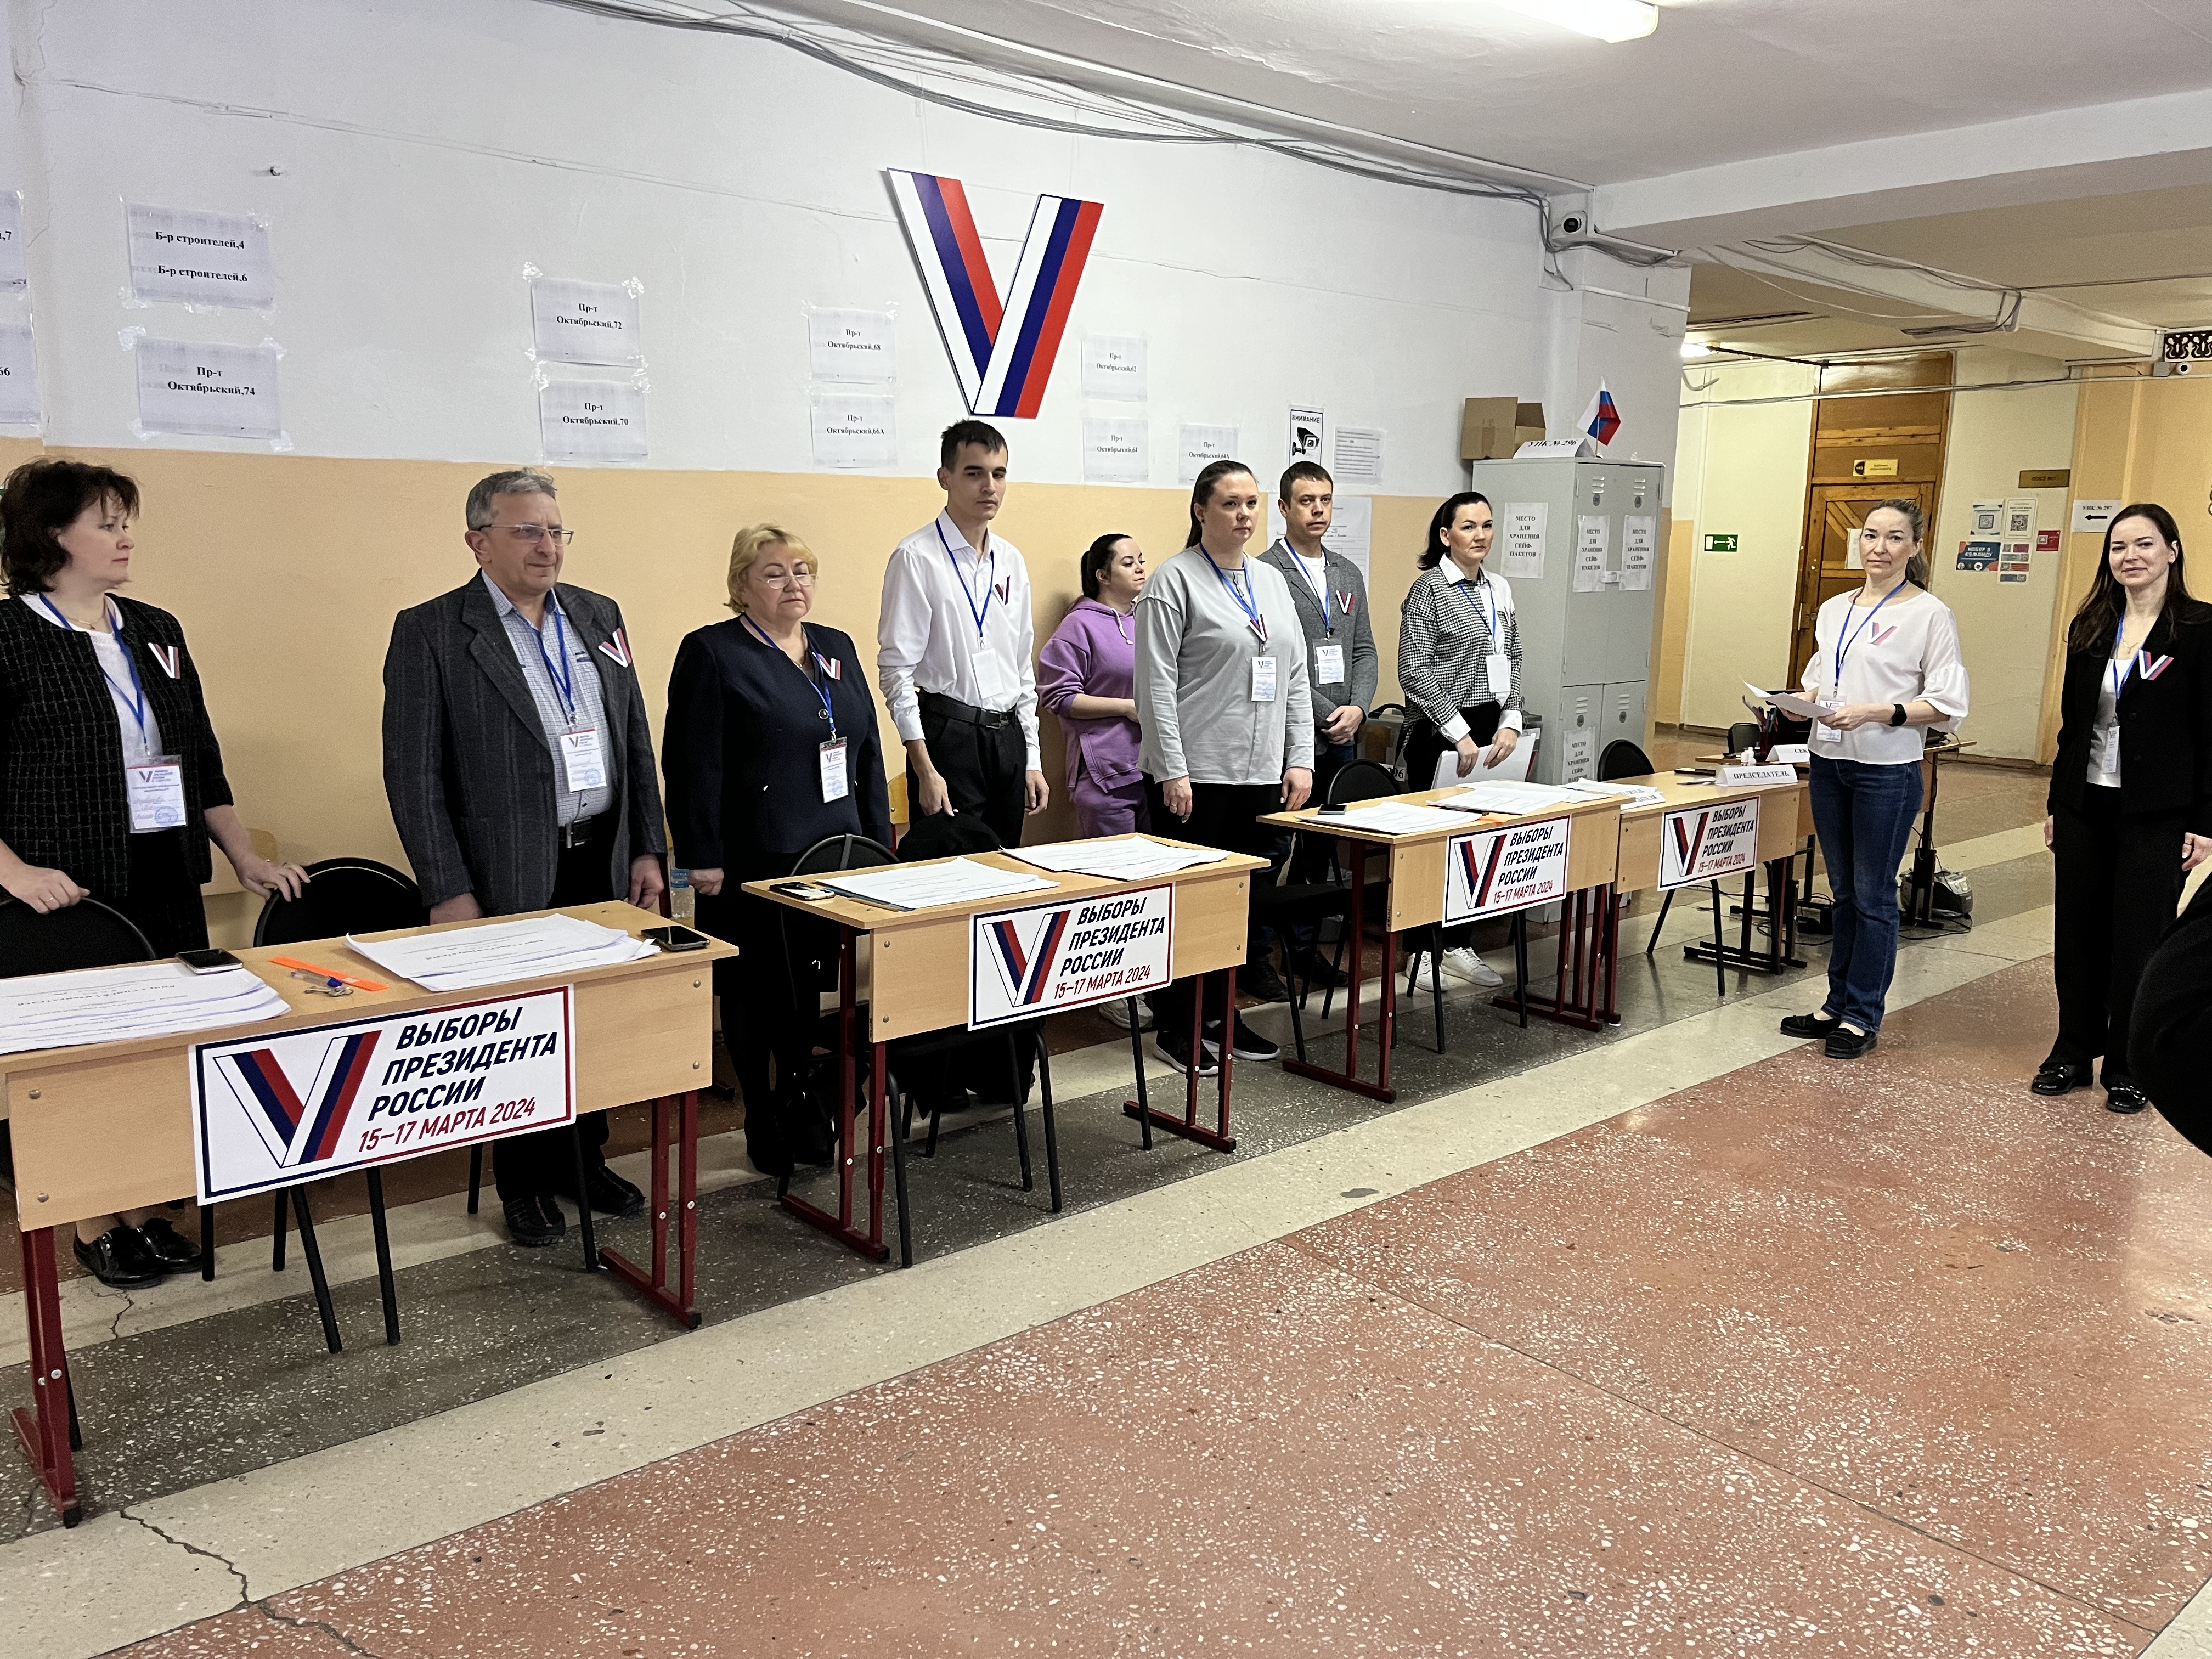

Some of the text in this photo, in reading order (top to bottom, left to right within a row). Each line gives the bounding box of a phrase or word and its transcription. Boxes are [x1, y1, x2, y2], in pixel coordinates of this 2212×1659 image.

[155, 231, 245, 249] Б-р строителей,4
[158, 265, 176, 276] Б-р
[579, 303, 598, 313] Пр-т
[557, 315, 622, 329] Октябрьский,72
[846, 329, 861, 337] Пр-т
[197, 366, 223, 378] Пр-т
[168, 381, 255, 396] Октябрьский,74
[584, 402, 603, 412] Пр-т
[563, 416, 629, 426] Октябрьский,70
[847, 414, 863, 423] Пр-т
[1734, 771, 1790, 780] ПРЕДСЕДАТЕЛЬ
[1712, 805, 1746, 823] ВЫБОРЫ
[1510, 826, 1554, 847] ВЫБОРЫ
[1707, 820, 1754, 840] ПРЕЗИДЕНТА
[1504, 842, 1564, 867] ПРЕЗИДЕНТА
[1702, 840, 1734, 857] РОССИИ
[1714, 856, 1732, 868] МАРТА
[1733, 853, 1746, 865] 2024
[1498, 866, 1538, 887] РОССИИ
[1513, 884, 1536, 900] МАРТА
[1537, 880, 1553, 894] 2024
[1077, 897, 1147, 925] ВЫБОРЫ
[1068, 917, 1165, 951] ПРЕЗИДЕНТА
[1060, 947, 1125, 977] РОССИИ
[1086, 971, 1123, 992] МАРТА
[1125, 964, 1151, 984] 2024
[396, 1007, 523, 1050] ВЫБОРЫ
[381, 1032, 558, 1086] ПРЕЗИДЕНТА
[368, 1076, 486, 1121] РОССИИ
[419, 1107, 486, 1141] МАРТА
[489, 1096, 535, 1124] 2024
